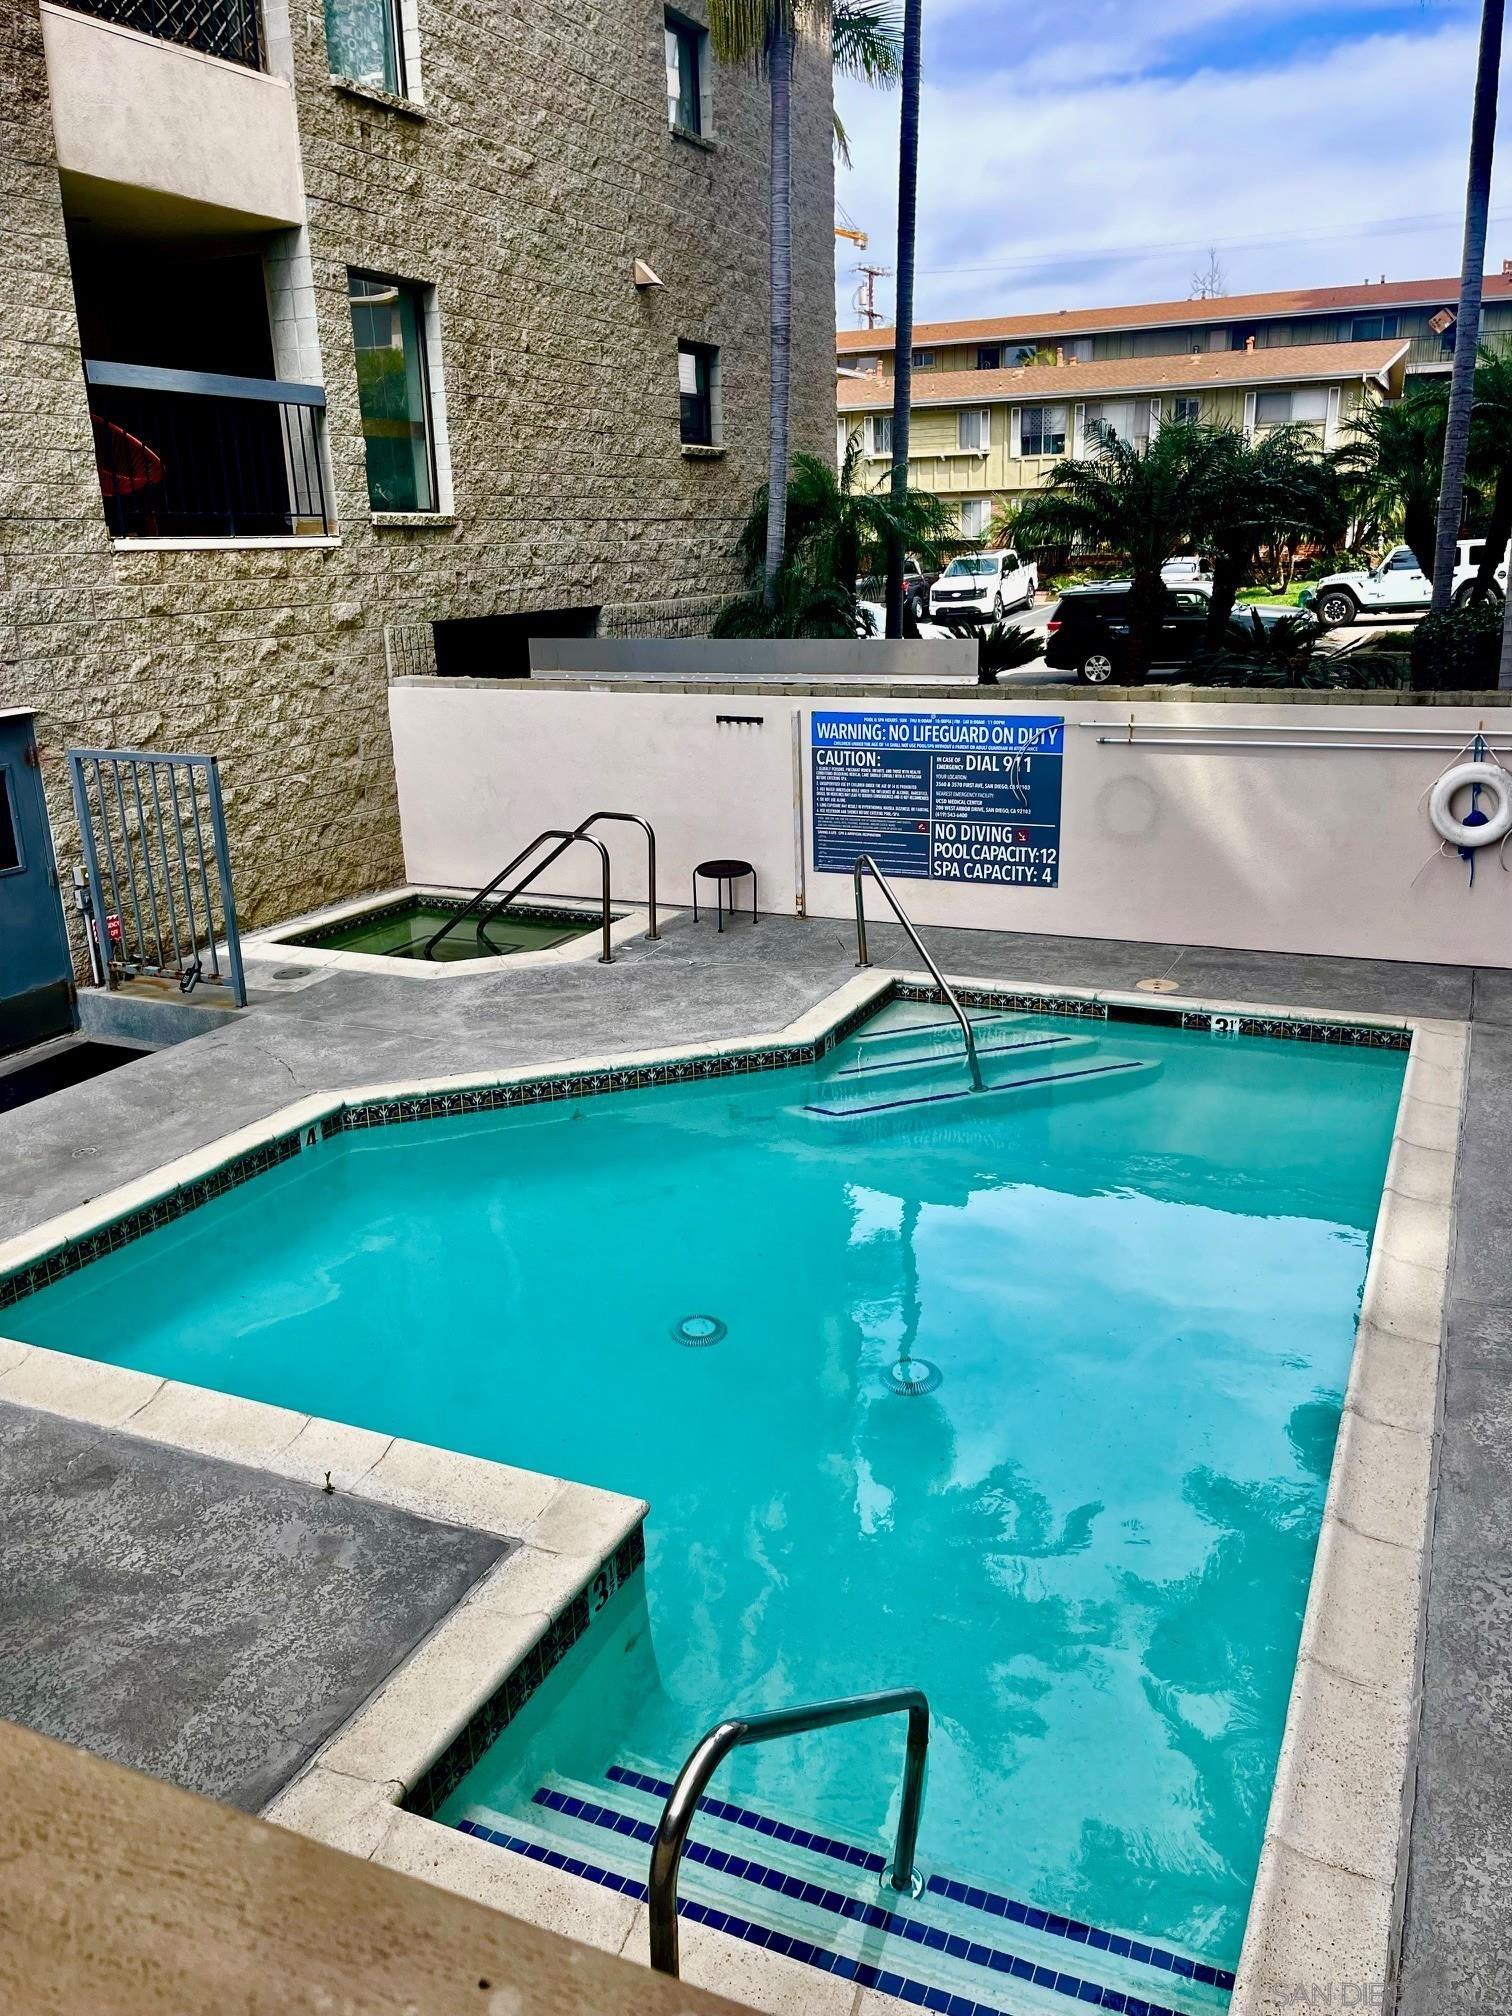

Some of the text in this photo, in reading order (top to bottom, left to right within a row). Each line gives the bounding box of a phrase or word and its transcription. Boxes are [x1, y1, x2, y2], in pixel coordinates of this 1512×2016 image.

[817, 723, 1058, 745] WARNING: NO LIFEGUARD ON DUTY
[816, 750, 881, 766] CAUTION:
[966, 755, 999, 771] DIAL
[935, 824, 1012, 843] NO DIVING
[934, 843, 970, 859] POOL
[971, 845, 1039, 863] CAPACITY:
[1040, 849, 1056, 864] 12
[934, 861, 960, 877] SPA
[964, 863, 1037, 882] CAPACITY:
[1042, 868, 1052, 883] 4
